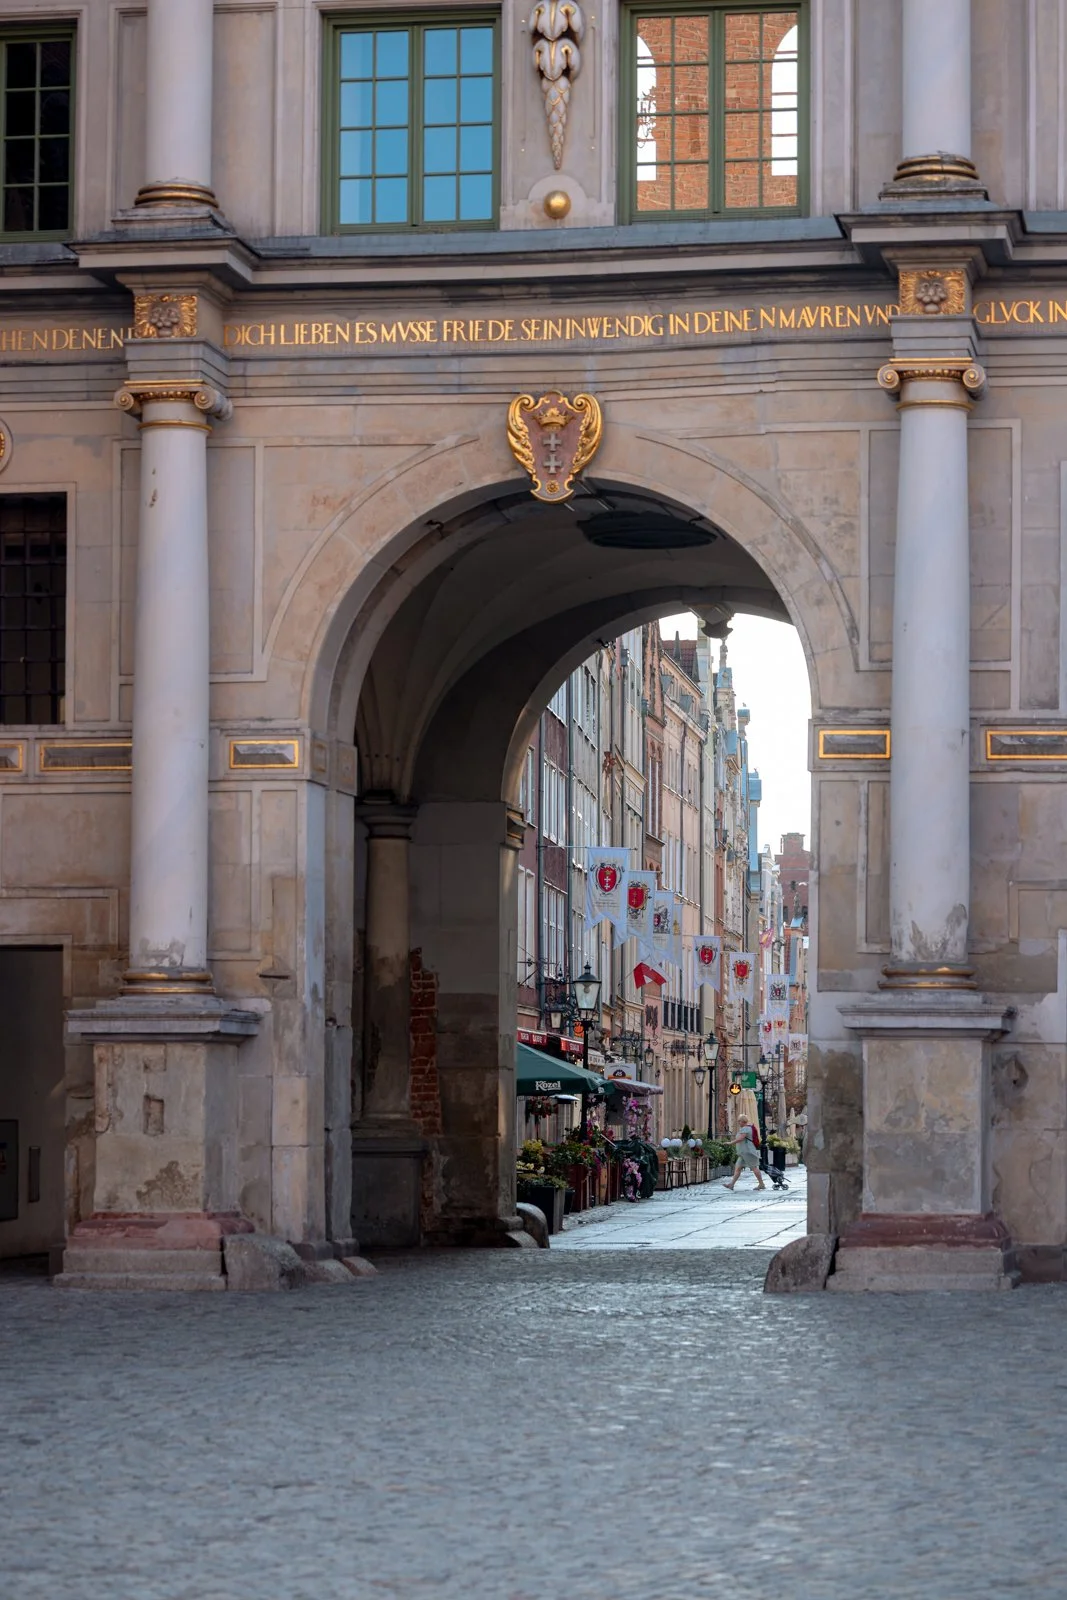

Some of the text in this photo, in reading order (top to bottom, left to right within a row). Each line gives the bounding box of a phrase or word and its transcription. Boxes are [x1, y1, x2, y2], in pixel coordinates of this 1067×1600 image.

[973, 301, 1043, 324] GLVCK
[224, 324, 275, 346] DICH
[280, 322, 350, 344] LIEBEN
[355, 322, 377, 343] ES
[381, 321, 437, 343] MVSSE
[443, 319, 517, 341] FRIEDE
[521, 318, 562, 340] SEIN
[669, 312, 690, 336] IN
[782, 305, 861, 329] MAVREN
[536, 1080, 561, 1090] Kozel
